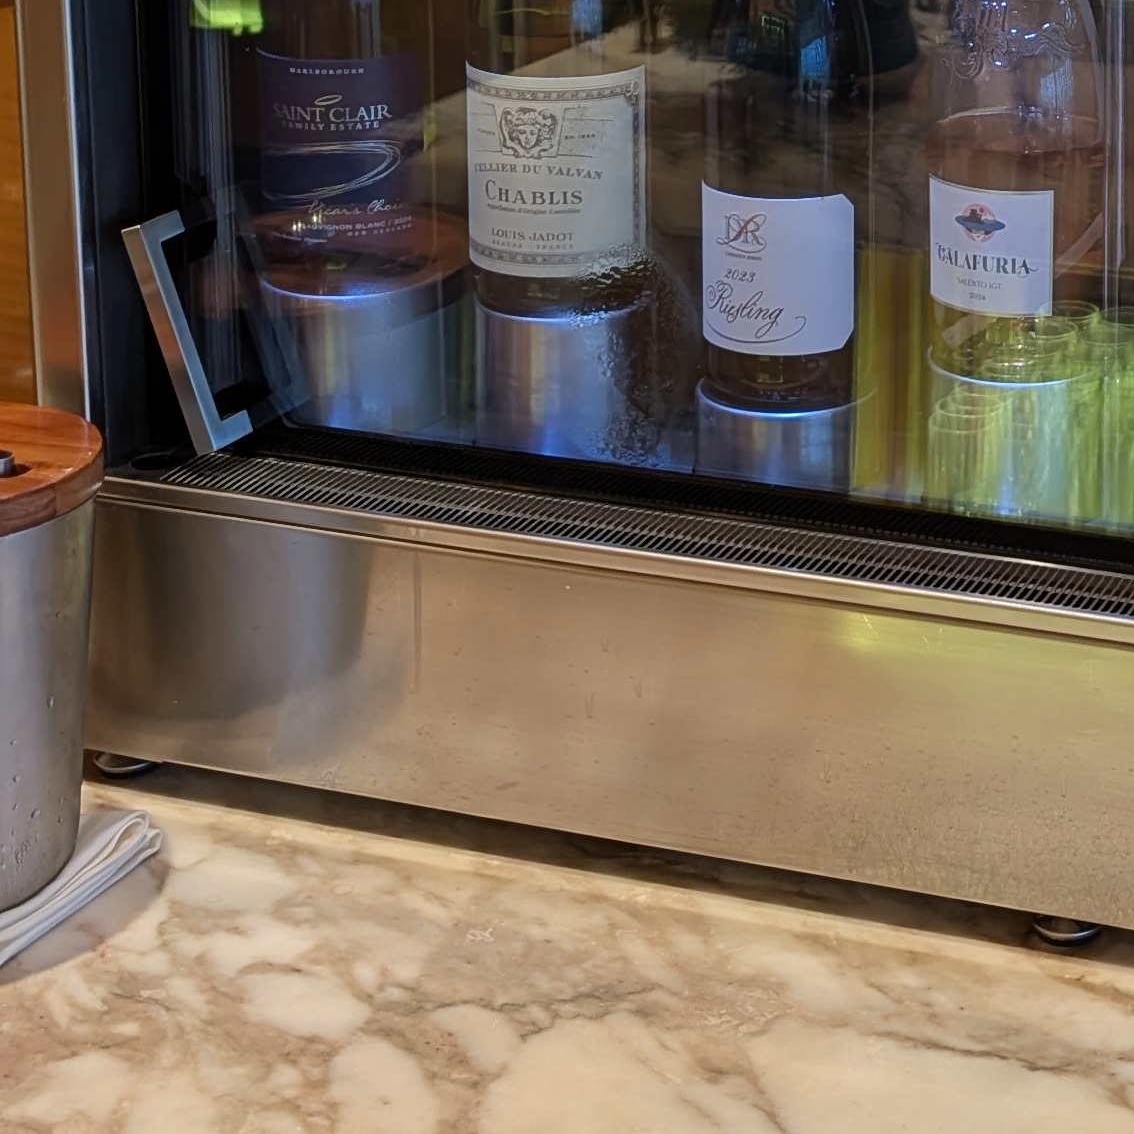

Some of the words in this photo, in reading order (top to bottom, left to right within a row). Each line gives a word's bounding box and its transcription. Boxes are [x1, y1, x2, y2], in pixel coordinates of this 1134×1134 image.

[273, 102, 325, 123] SAINT
[328, 104, 394, 123] CLAIR
[329, 120, 380, 132] ESTATE
[521, 164, 542, 175] DU
[546, 165, 604, 181] VALVAN
[484, 179, 584, 206] CHABLIS
[491, 227, 526, 241] LOUIS
[528, 232, 576, 242] JADOT
[935, 242, 1039, 279] CALAFURIA
[724, 267, 757, 283] 2023
[706, 279, 785, 339] Riesling
